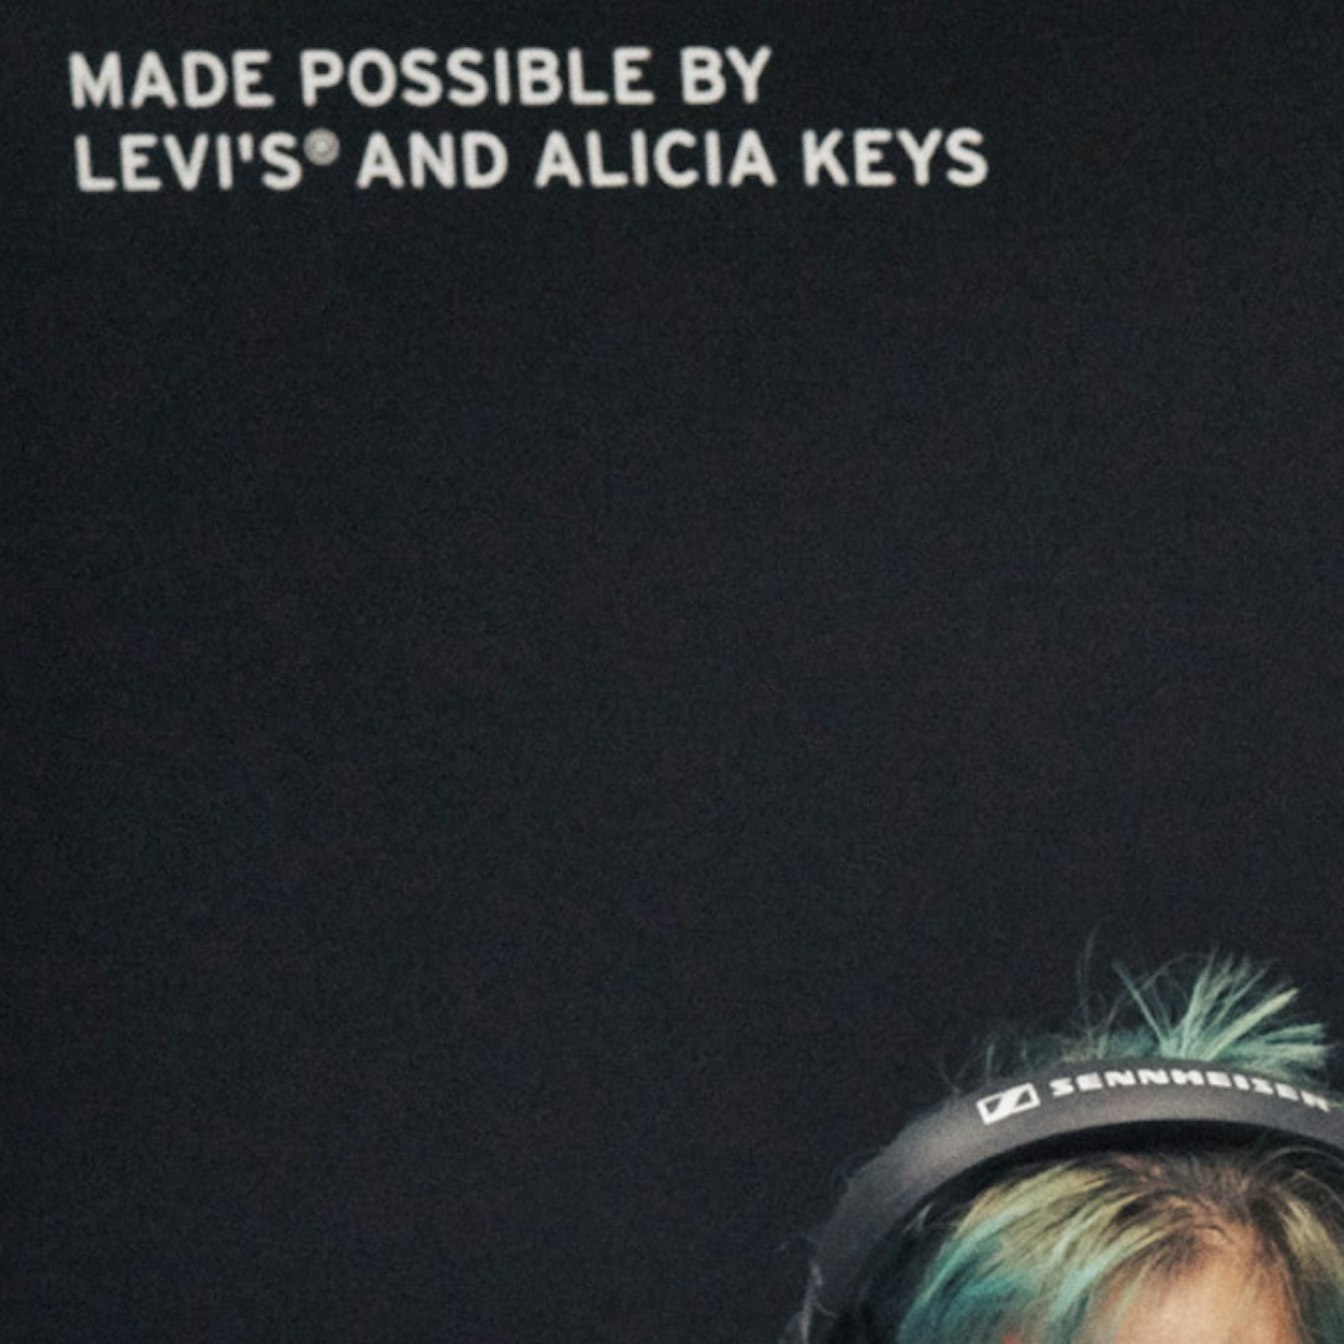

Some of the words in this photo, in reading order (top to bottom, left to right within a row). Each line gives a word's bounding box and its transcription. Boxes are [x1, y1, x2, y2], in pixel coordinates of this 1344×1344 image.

[69, 49, 274, 109] MADE
[300, 46, 655, 107] POSSIBLE
[680, 45, 771, 105] BY
[356, 131, 508, 189] AND
[535, 129, 777, 188] ALICIA
[802, 127, 988, 187] KEYS
[1049, 1068, 1330, 1112] SENNHEISER
